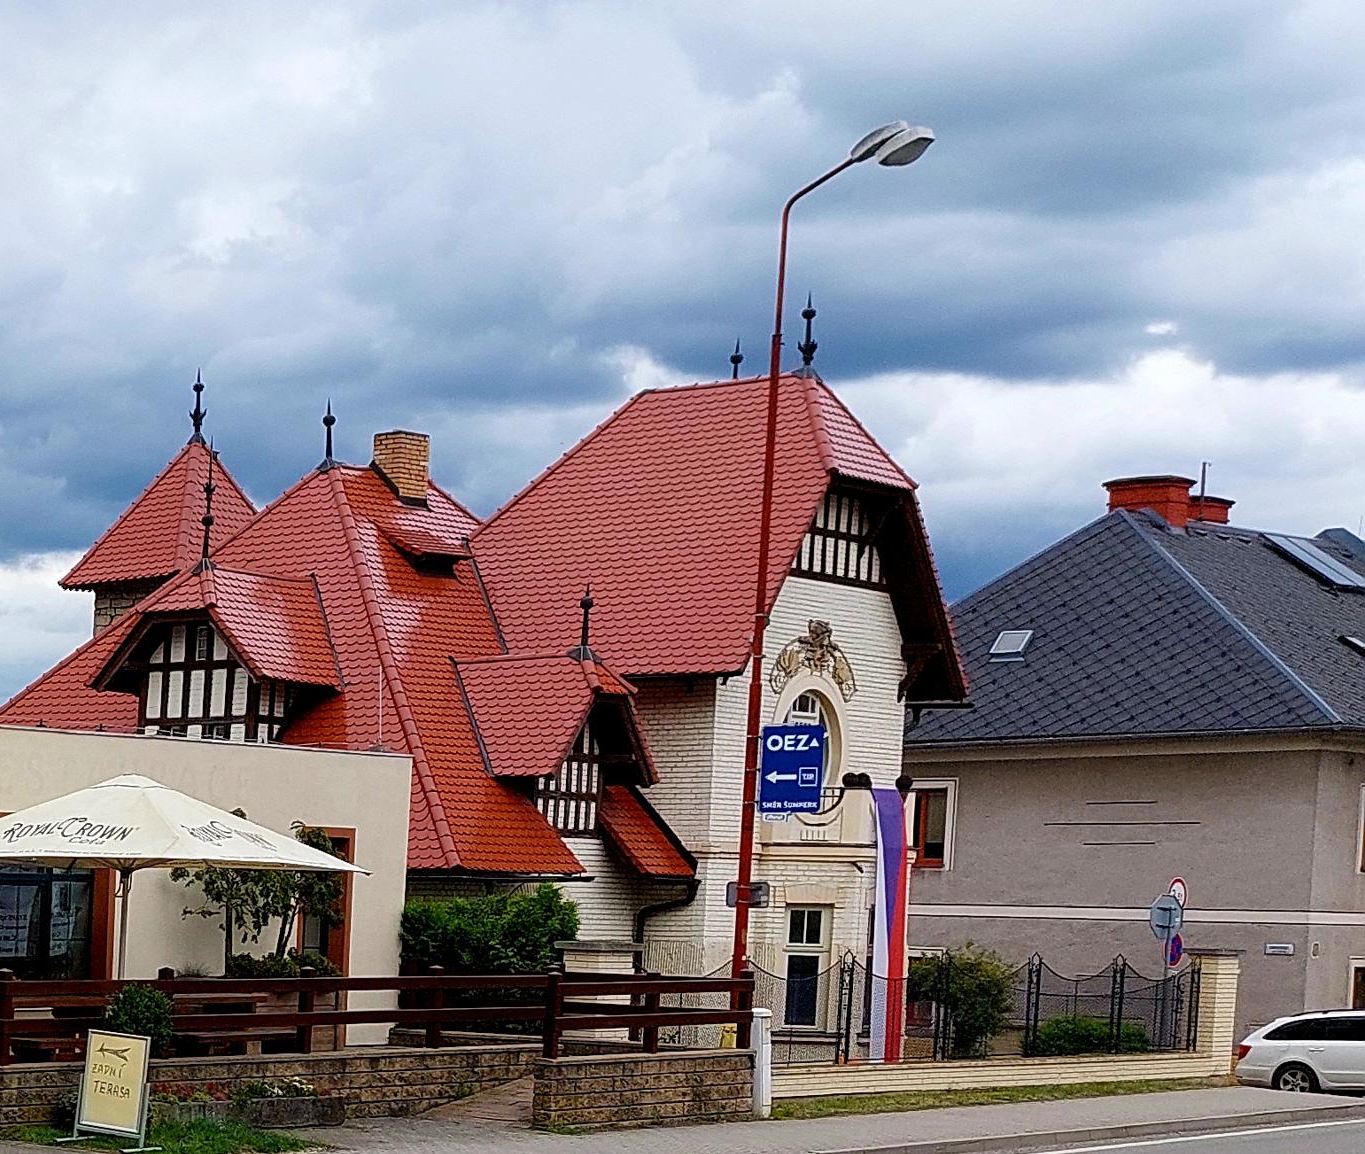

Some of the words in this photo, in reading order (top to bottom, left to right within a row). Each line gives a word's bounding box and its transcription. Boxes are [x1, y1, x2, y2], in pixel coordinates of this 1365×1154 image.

[766, 734, 810, 751] OEZ
[1, 822, 59, 843] ROYAL
[57, 817, 135, 841] CROWN
[68, 836, 106, 845] Cola
[91, 1063, 127, 1079] ZADNÍ
[93, 1079, 130, 1099] TERASA
